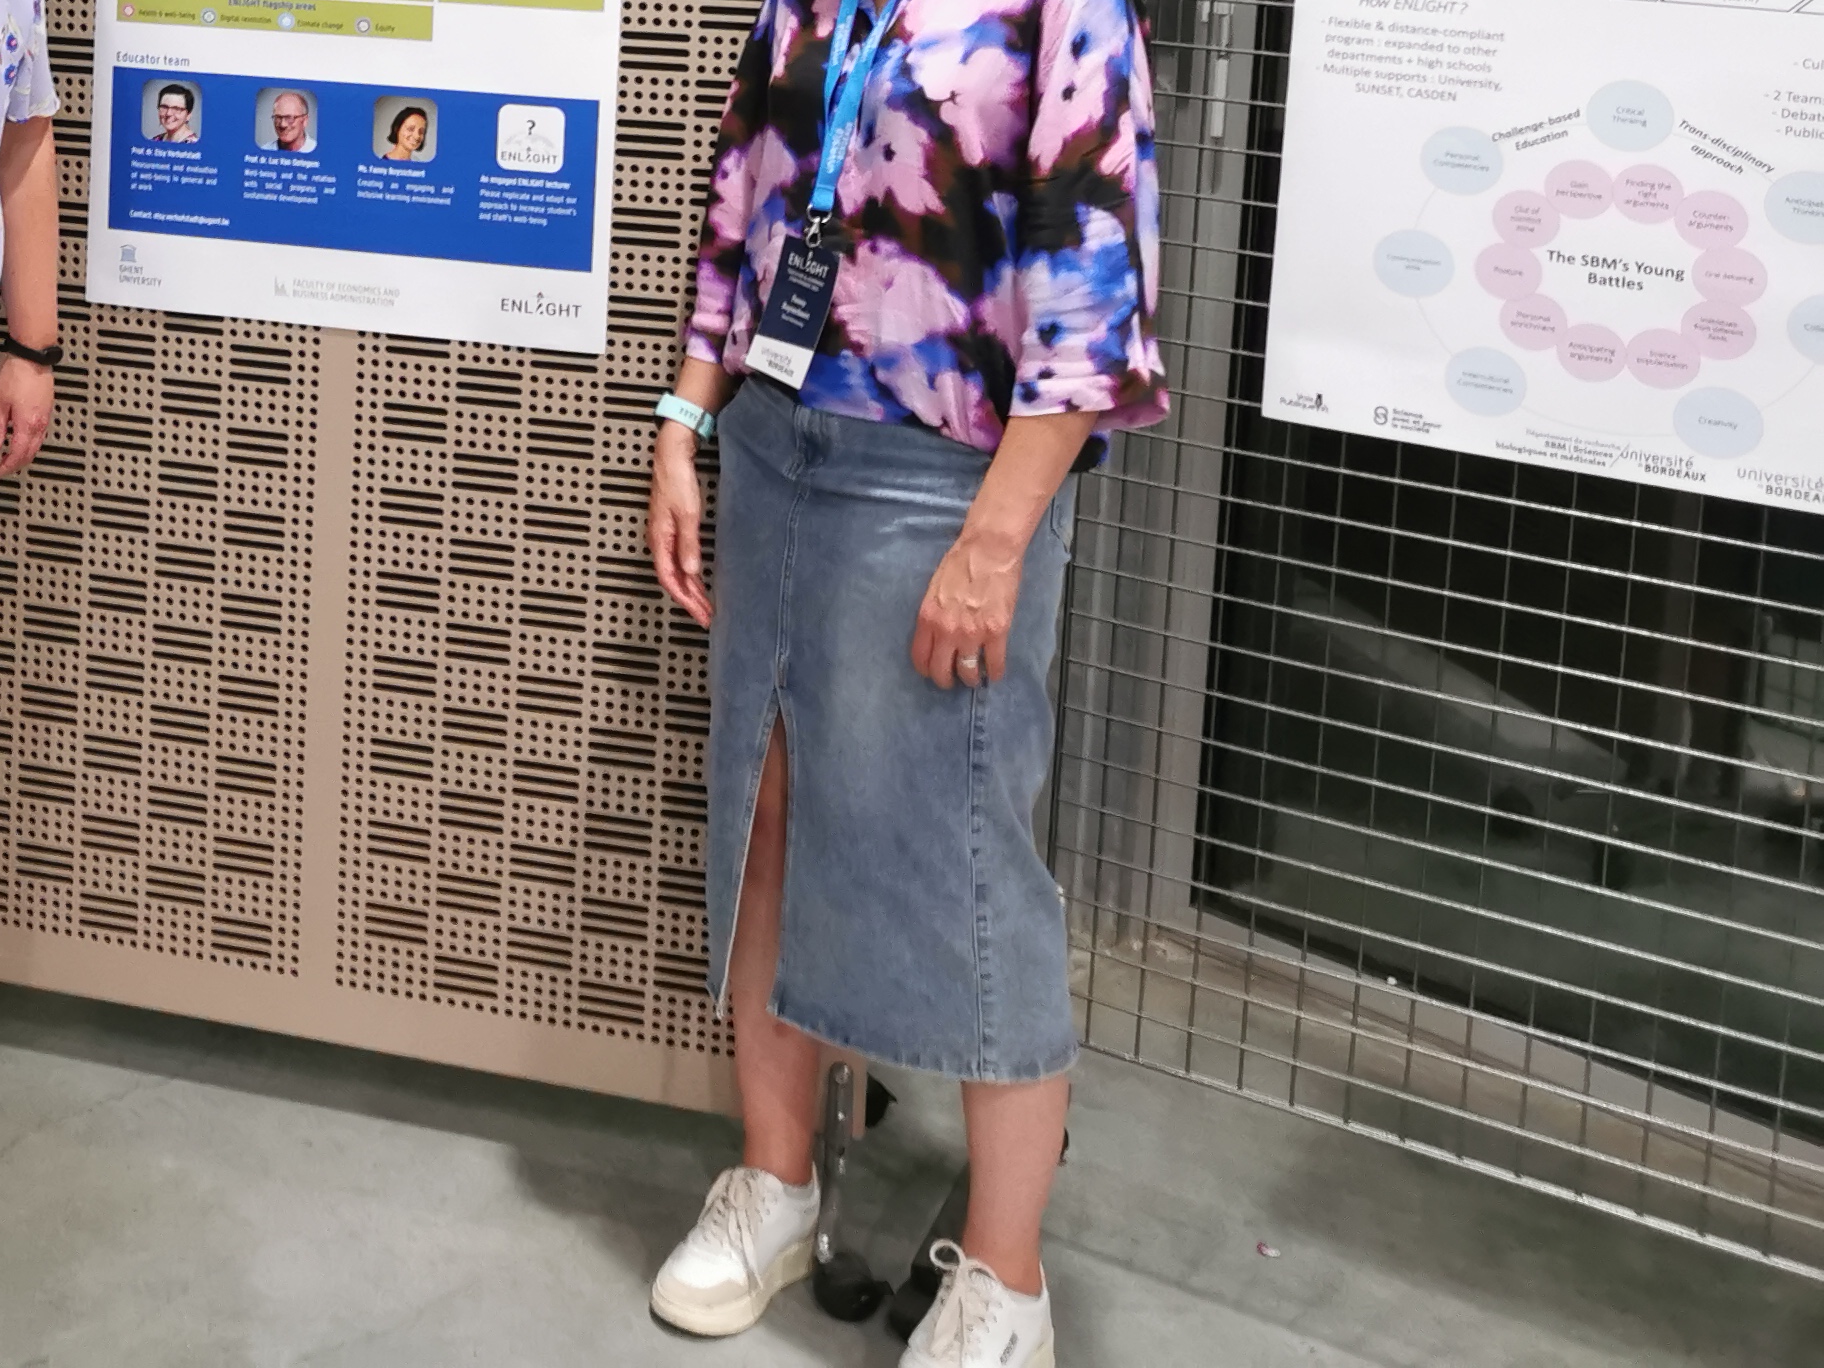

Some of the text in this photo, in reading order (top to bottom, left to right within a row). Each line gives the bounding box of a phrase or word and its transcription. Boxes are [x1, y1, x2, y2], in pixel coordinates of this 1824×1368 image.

[295, 3, 316, 11] areas
[1328, 17, 1371, 31] Flexible
[1388, 22, 1505, 42] distance-compliant
[1325, 34, 1498, 57] program expanded to other
[116, 51, 190, 67] Educator team
[1327, 50, 1493, 73] departments high schools
[1323, 64, 1503, 91] Multiple supports University,
[1355, 83, 1457, 102] SUNSET, CASDEN
[1491, 108, 1581, 143] Challenge-based
[1515, 130, 1569, 151] Education
[1678, 119, 1775, 174] Trans-disciplinary
[1691, 144, 1744, 175] approach
[119, 264, 144, 275] GHENT
[1547, 250, 1685, 282] The SBM's Young
[119, 275, 162, 288] UNIVERSITY
[292, 278, 325, 290] FACULTY
[338, 282, 381, 296] ECONOMICS
[1587, 272, 1644, 291] Battles
[329, 292, 394, 307] ADMINISTRATION
[1621, 448, 1695, 470] université
[1644, 465, 1706, 482] BORDEAUX
